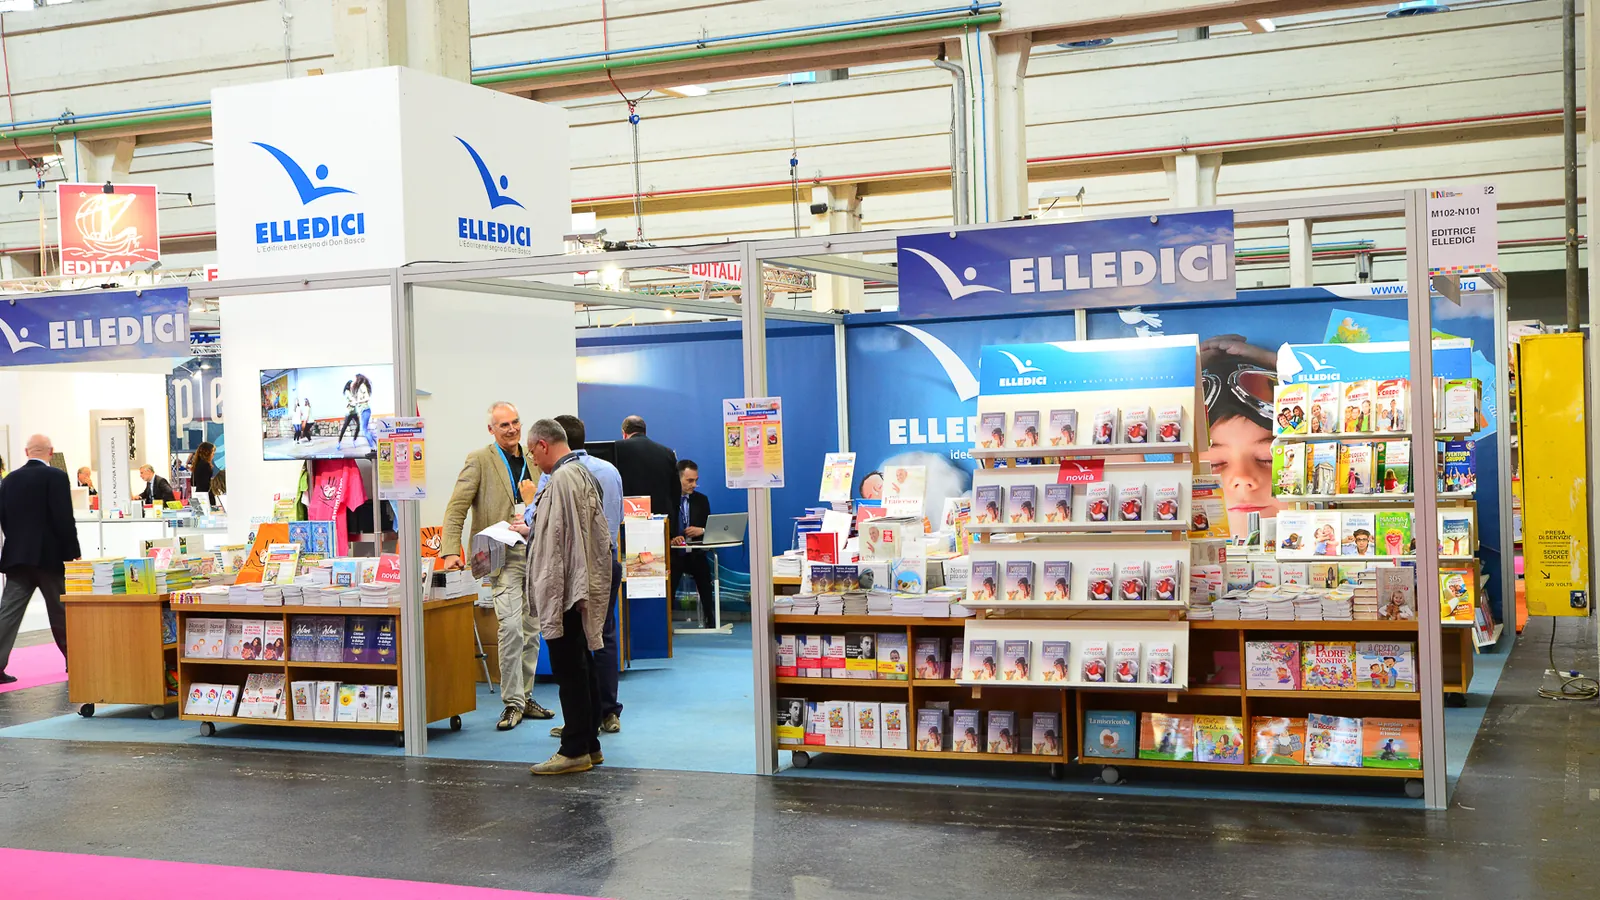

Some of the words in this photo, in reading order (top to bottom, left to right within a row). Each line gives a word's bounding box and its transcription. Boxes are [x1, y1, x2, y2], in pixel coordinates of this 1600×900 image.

[1488, 186, 1494, 194] 2
[1431, 207, 1480, 218] M102-N101
[256, 212, 364, 244] ELLEDICI
[458, 216, 531, 247] ELLEDICI
[1431, 227, 1476, 237] EDITRICE
[1432, 236, 1475, 246] ELLEDICI
[1010, 244, 1228, 294] ELLEDICI
[48, 312, 185, 350] ELLEDICI
[999, 376, 1047, 387] ELLEDICI
[1298, 373, 1340, 381] ELLEDICI
[1315, 644, 1346, 658] PADRE
